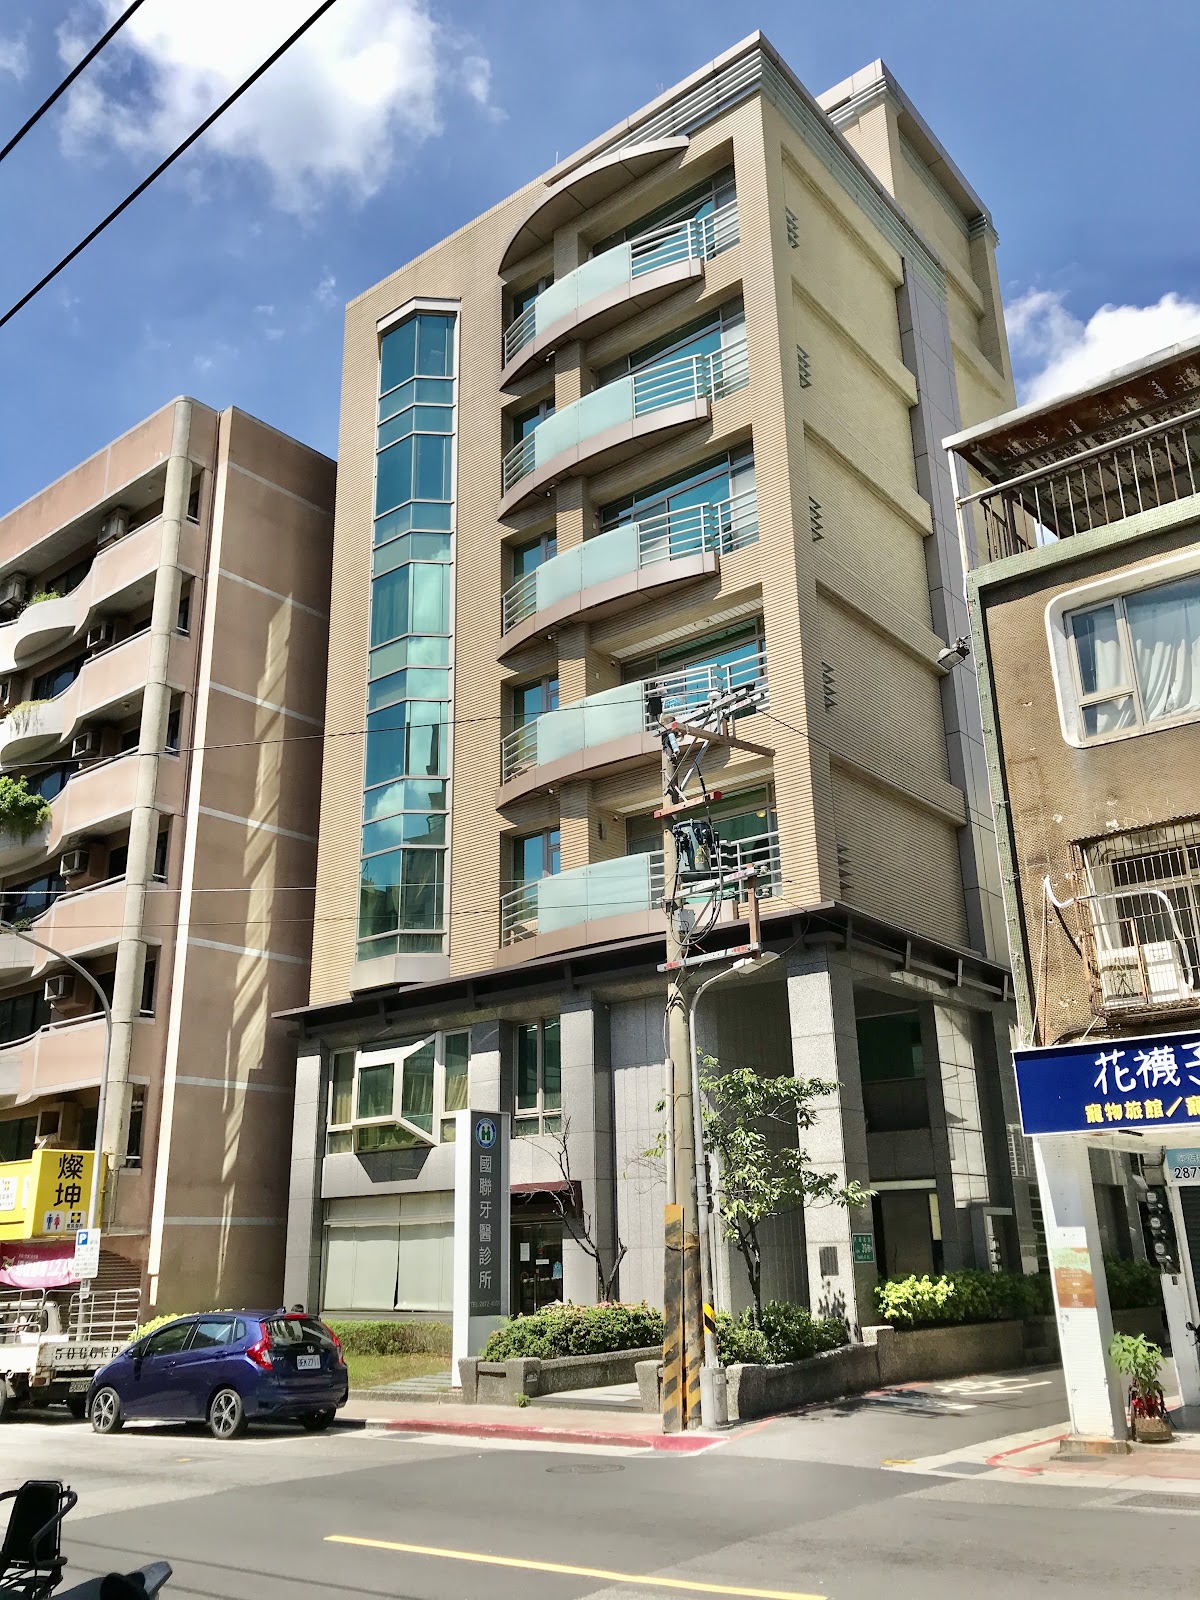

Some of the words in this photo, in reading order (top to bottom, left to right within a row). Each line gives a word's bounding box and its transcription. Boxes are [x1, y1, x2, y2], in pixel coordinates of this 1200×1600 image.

[53, 1153, 84, 1209] 燦坤
[1174, 1167, 1200, 1179] 287
[479, 1155, 492, 1290] 國聯牙醫診所
